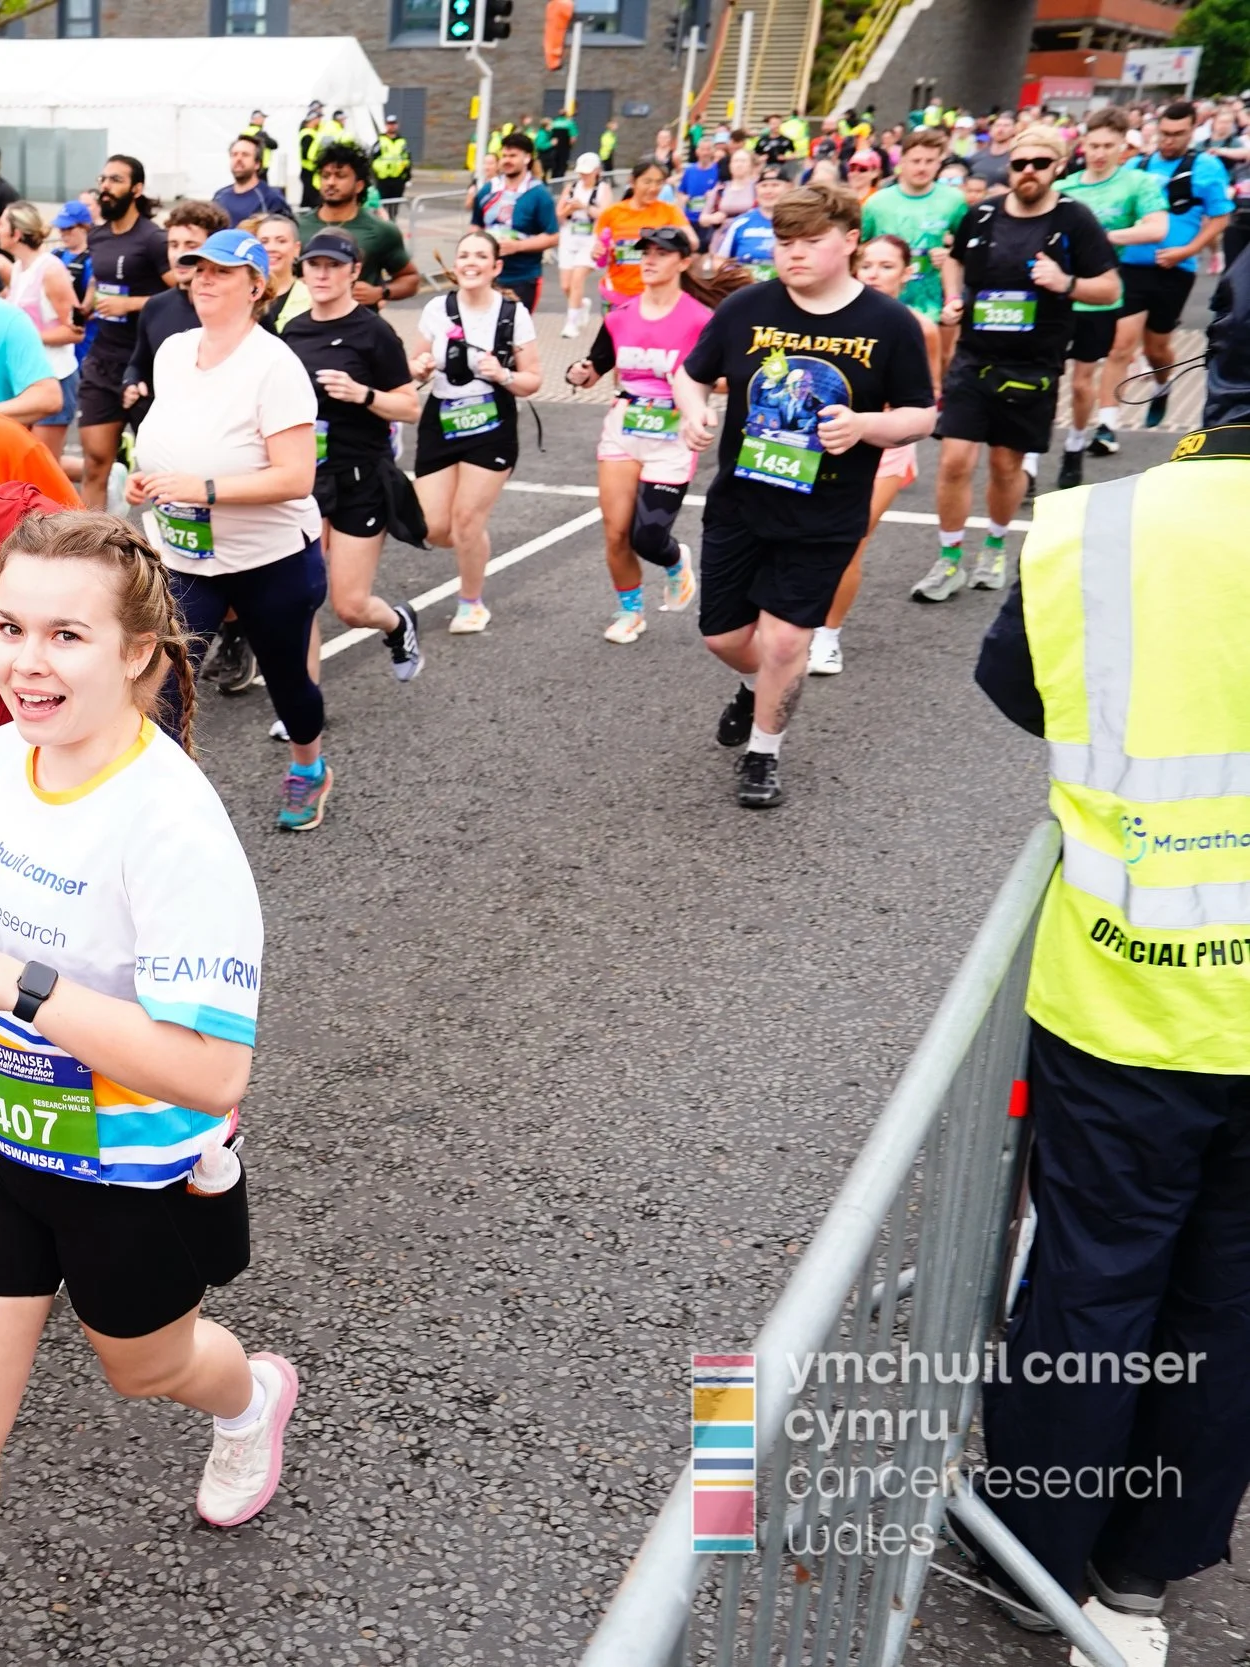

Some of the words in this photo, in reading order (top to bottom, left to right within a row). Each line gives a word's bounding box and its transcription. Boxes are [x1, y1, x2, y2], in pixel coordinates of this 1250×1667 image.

[746, 326, 879, 368] MEGADETH
[636, 414, 665, 431] 739
[753, 451, 801, 478] 1454
[23, 863, 88, 895] canser
[33, 1098, 67, 1111] RESEARCH
[67, 1104, 91, 1113] WALES
[62, 1094, 90, 1103] CANCER
